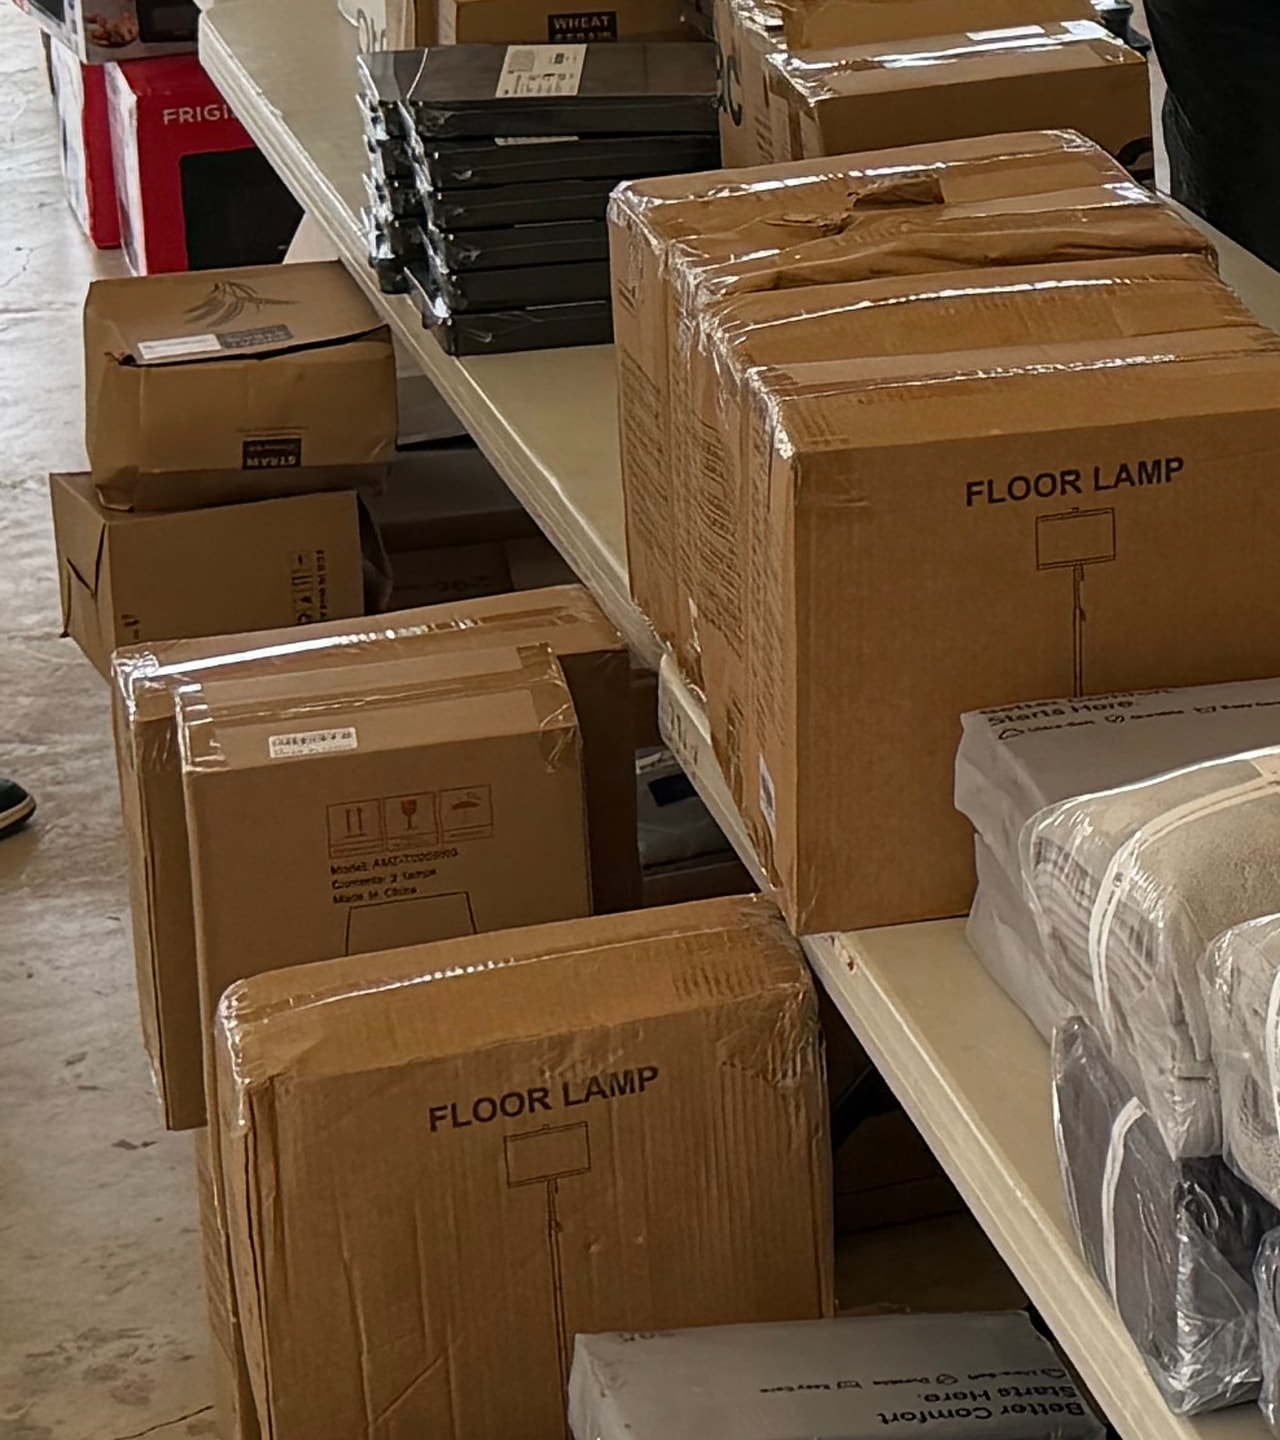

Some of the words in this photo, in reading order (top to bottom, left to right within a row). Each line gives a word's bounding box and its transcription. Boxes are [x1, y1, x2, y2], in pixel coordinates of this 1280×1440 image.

[552, 15, 609, 30] WHEAT
[162, 104, 234, 125] FRIGI
[966, 469, 1082, 507] FLOOR
[1094, 457, 1184, 491] LAMP
[989, 707, 1066, 726] Starts
[429, 1087, 552, 1132] FLOOR
[563, 1066, 659, 1107] LAMP
[1001, 1385, 1077, 1398] Starts
[877, 1405, 992, 1426] Comfort
[1001, 1401, 1085, 1417] Better
